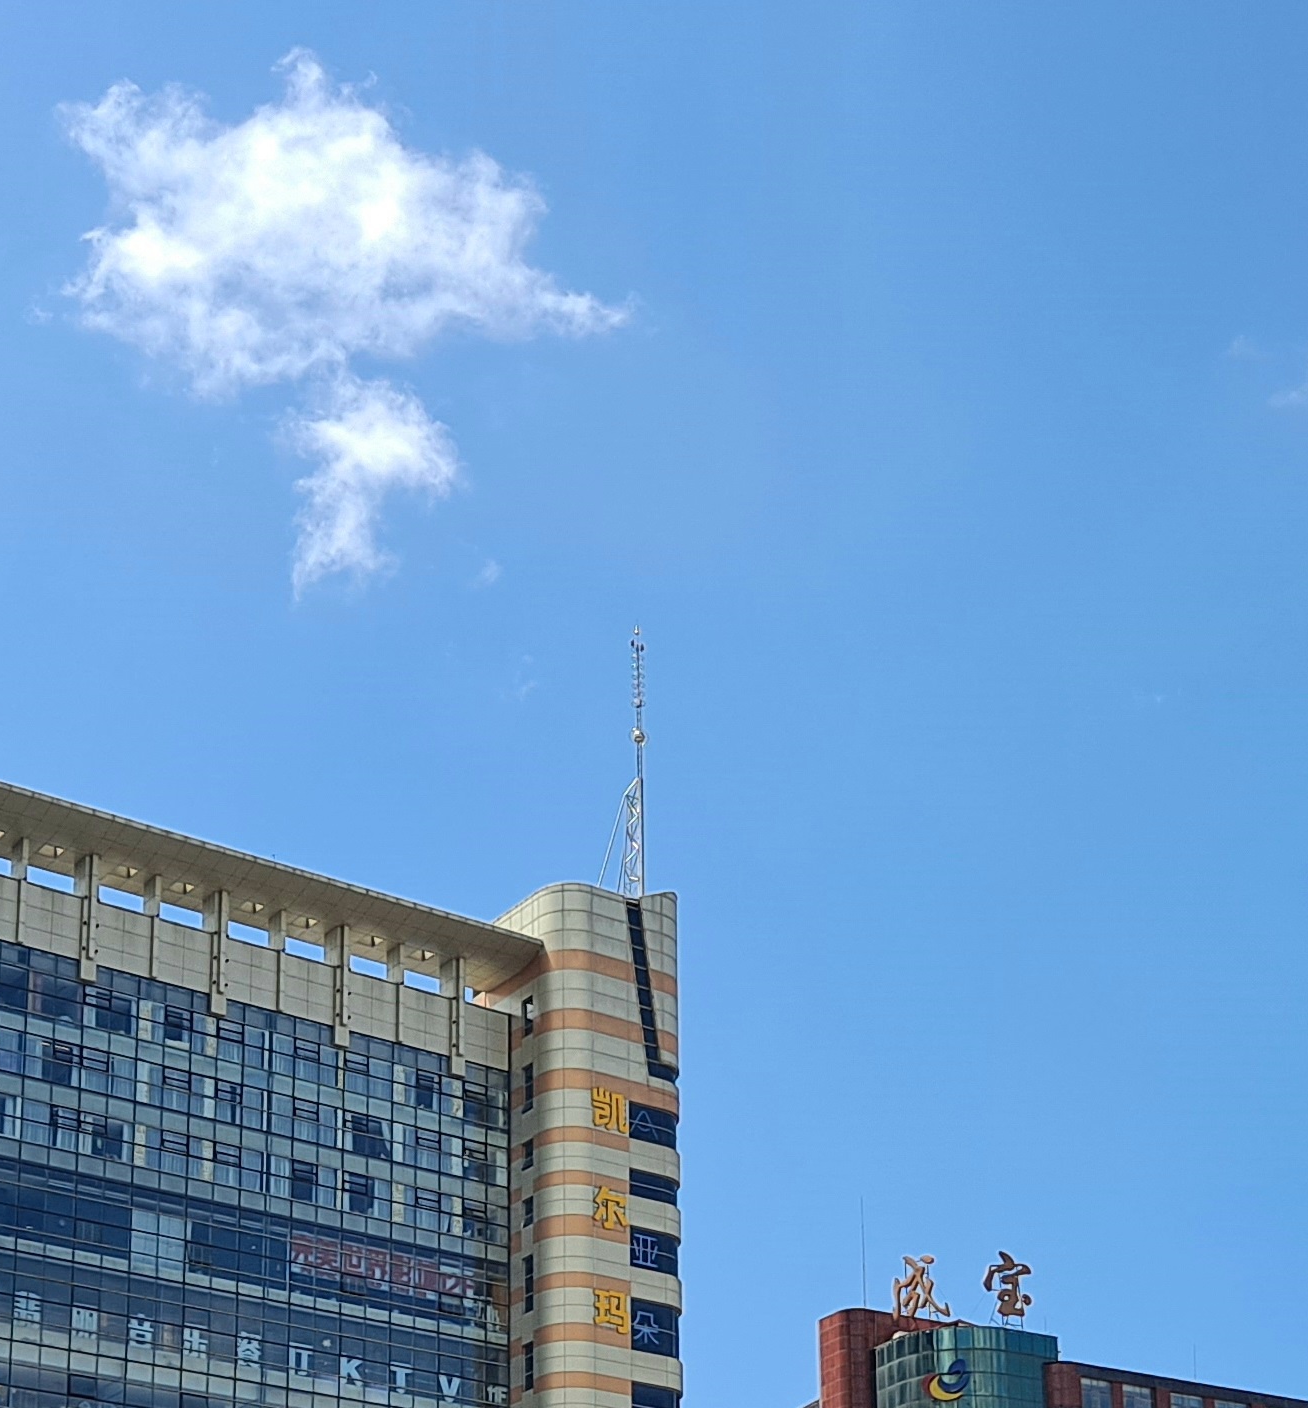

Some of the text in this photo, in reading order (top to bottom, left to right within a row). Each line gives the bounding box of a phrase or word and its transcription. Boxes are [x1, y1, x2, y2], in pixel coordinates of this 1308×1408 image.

[591, 1086, 630, 1335] 凯尔玛
[632, 1233, 660, 1345] 亚朵
